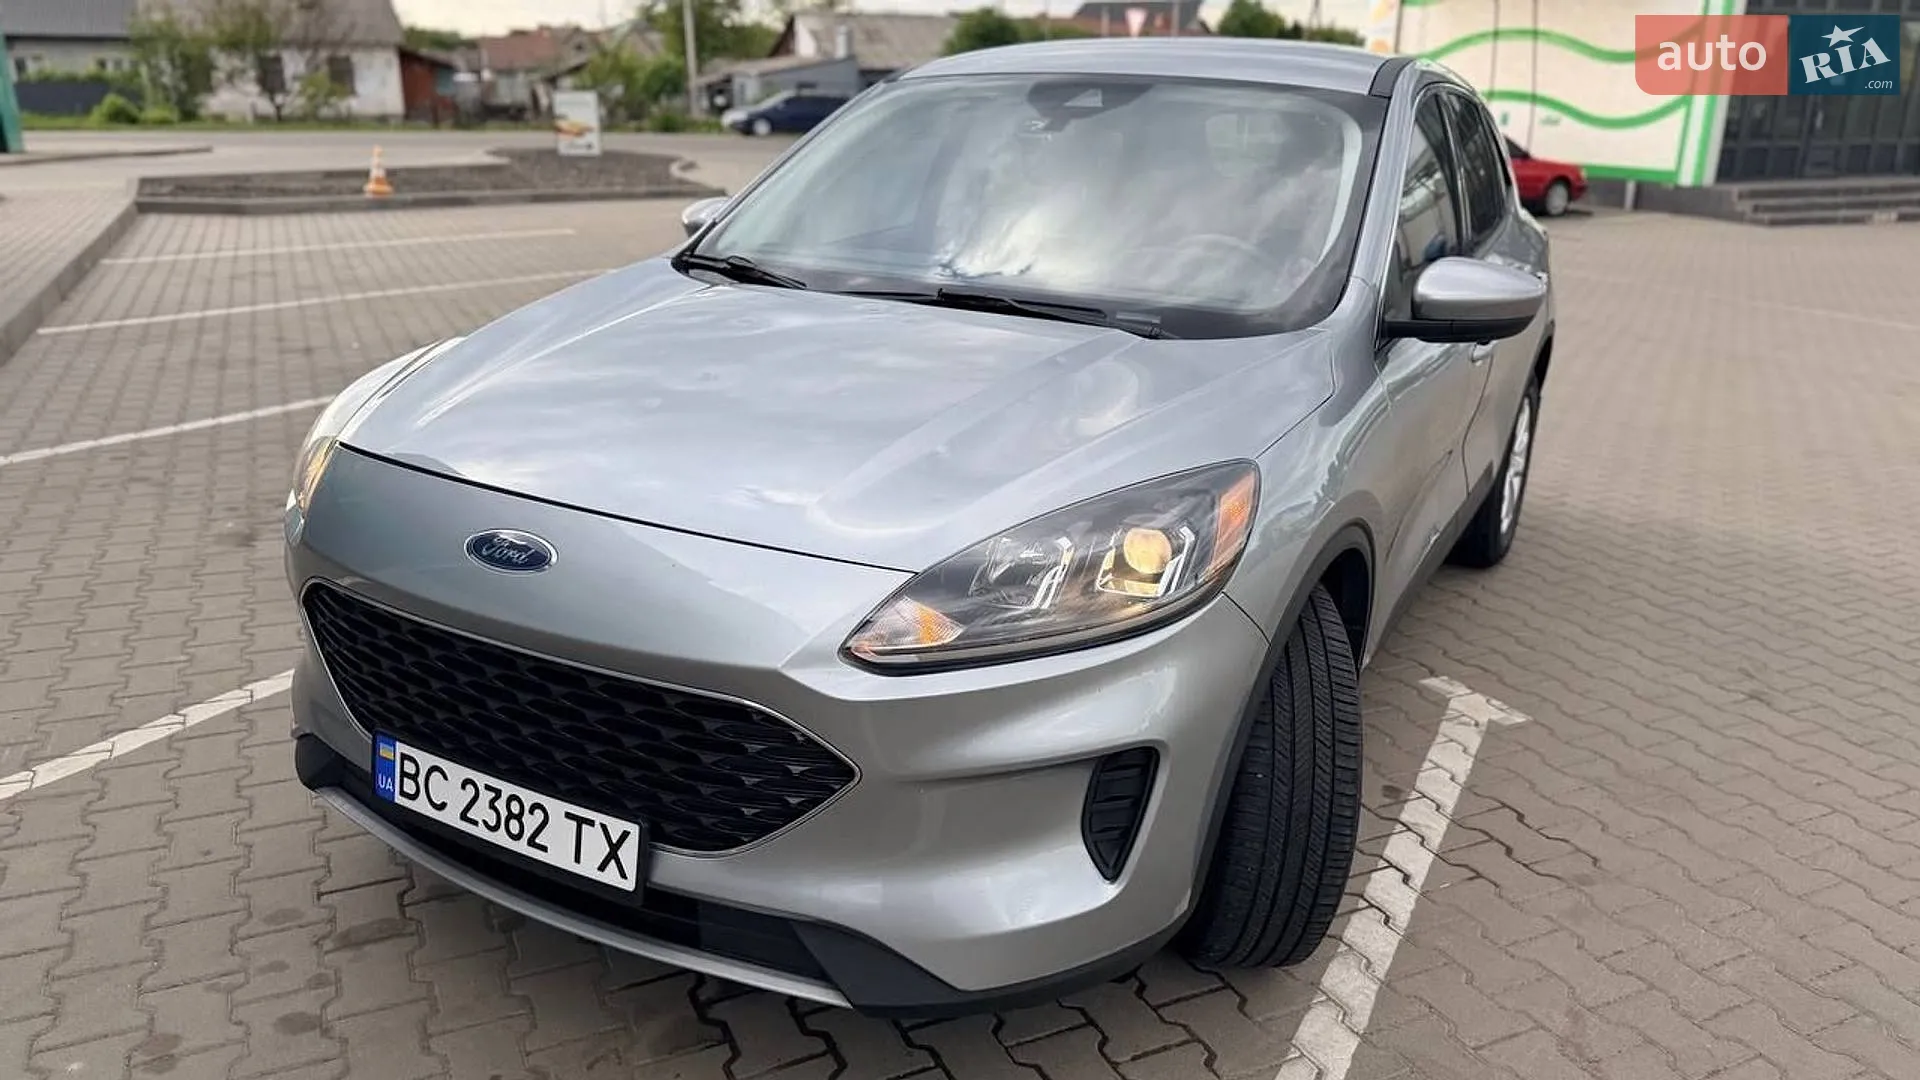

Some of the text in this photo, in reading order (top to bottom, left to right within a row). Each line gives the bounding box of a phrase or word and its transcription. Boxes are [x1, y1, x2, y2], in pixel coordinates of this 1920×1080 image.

[481, 537, 536, 564] Ford
[377, 773, 395, 792] UA
[399, 752, 631, 880] BC 2382 TX
